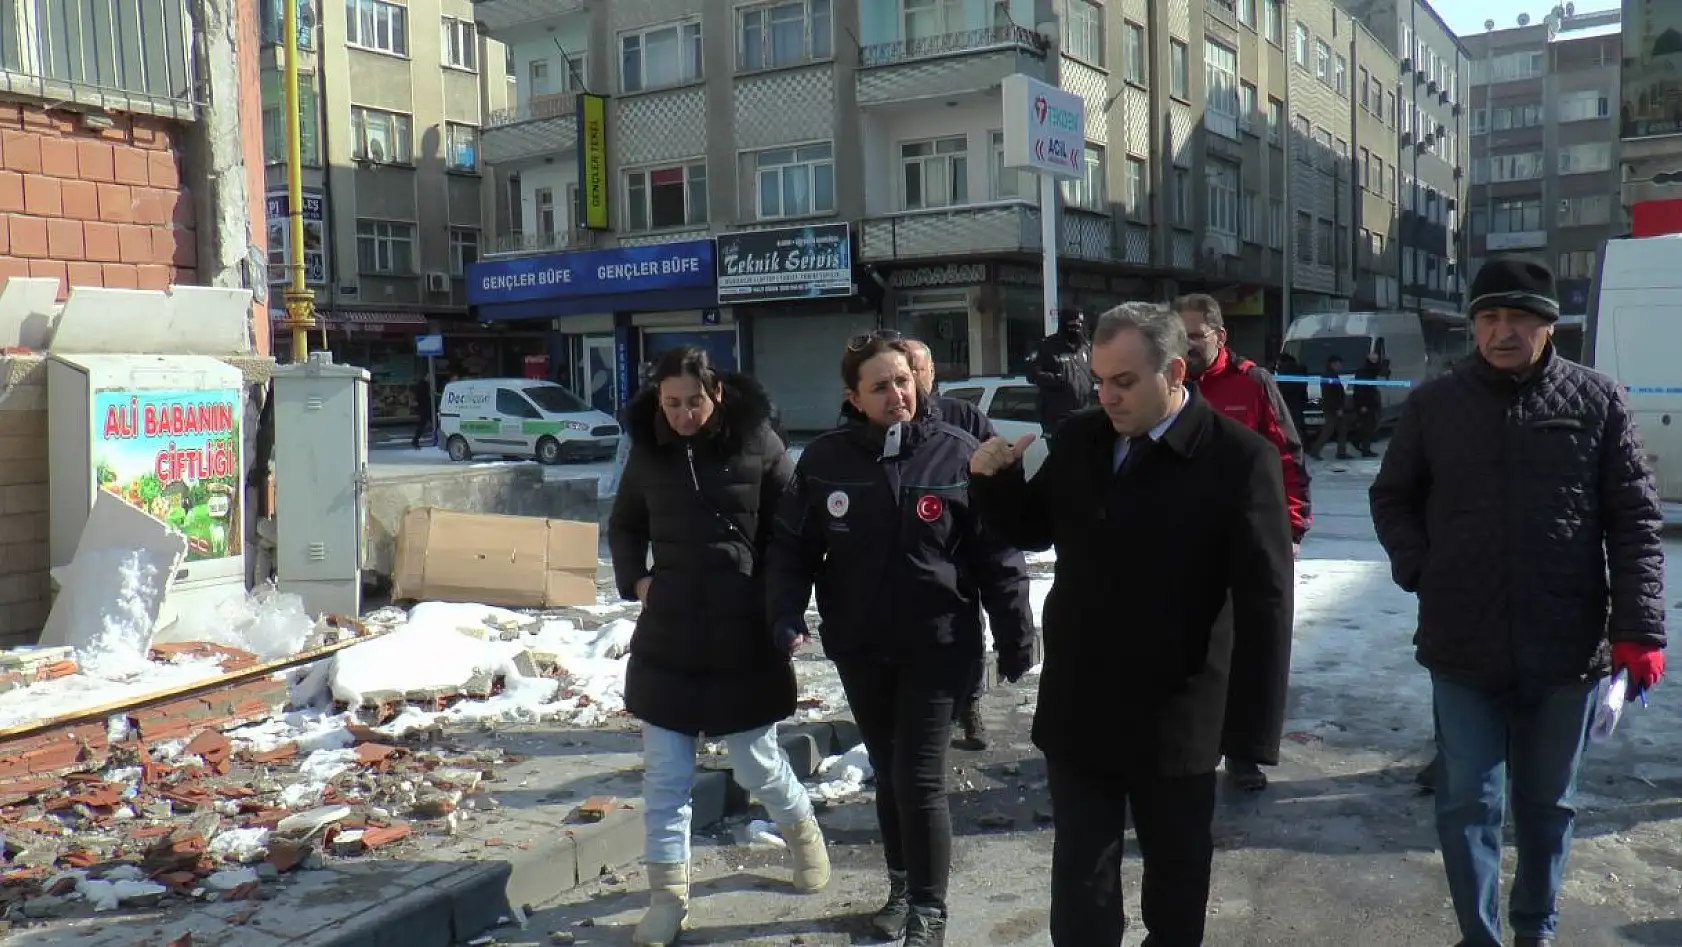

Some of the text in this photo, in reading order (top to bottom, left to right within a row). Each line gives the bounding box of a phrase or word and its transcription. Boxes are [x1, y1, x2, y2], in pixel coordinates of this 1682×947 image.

[597, 256, 700, 281] GENÇLER BÜFE
[724, 250, 781, 275] Teknik
[483, 268, 572, 291] GENÇLER BÜFE
[104, 396, 233, 440] ALİ BABANIN
[155, 439, 233, 486] ÇİFTLİĞİ
